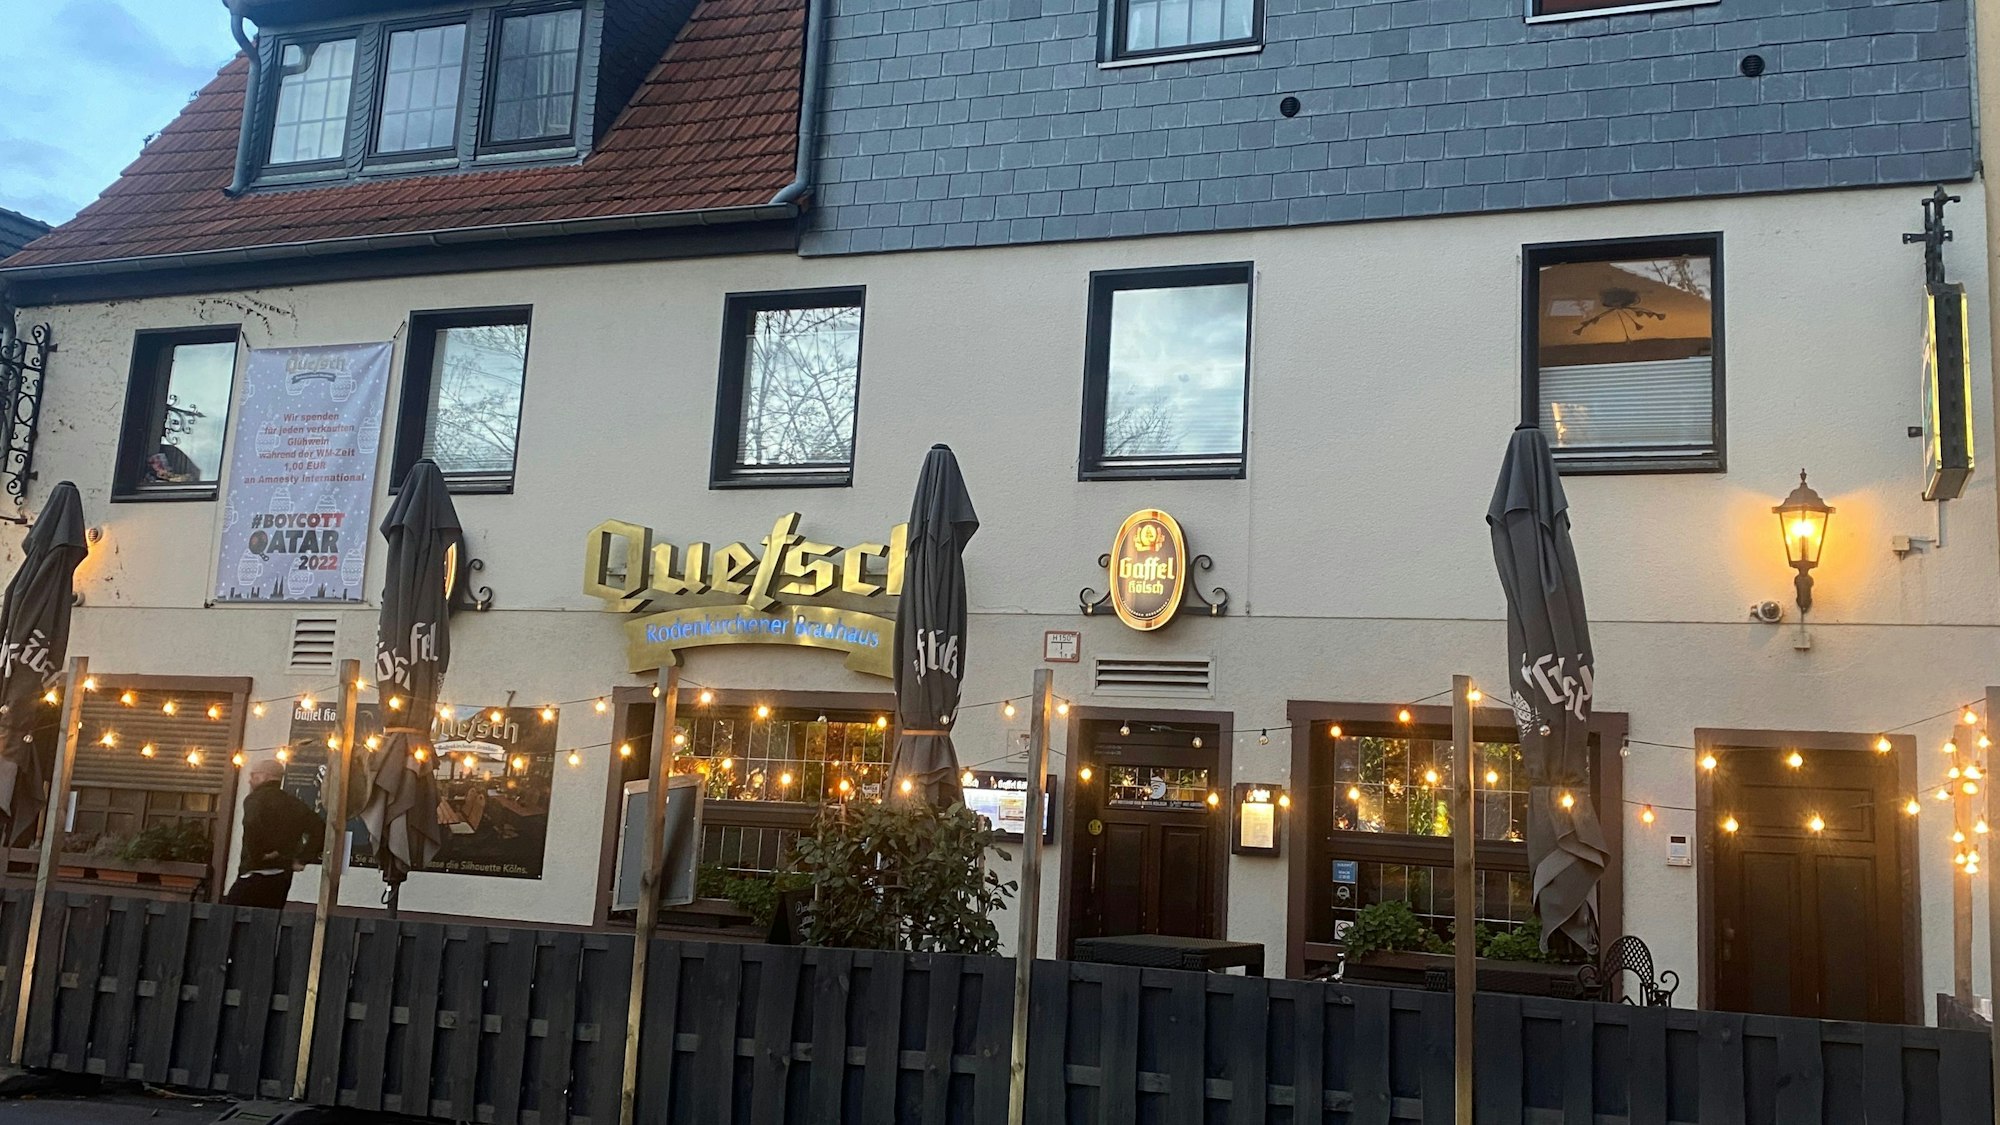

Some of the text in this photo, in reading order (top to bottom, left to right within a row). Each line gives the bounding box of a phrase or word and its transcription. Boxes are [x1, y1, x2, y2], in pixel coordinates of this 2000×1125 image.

[283, 412, 339, 423] Wir spenden
[264, 424, 355, 436] für jeden verkauften
[287, 436, 330, 446] Glühwein
[259, 447, 356, 459] während der WM-Zeit
[283, 461, 327, 472] 1,00 EUR
[243, 472, 365, 485] an Amnesty International
[251, 512, 346, 529] #BOYCOTT
[249, 530, 340, 557] QATAR
[298, 555, 338, 570] 2022
[1119, 556, 1175, 581] Gaffel
[1128, 580, 1164, 595] Kölsch
[646, 613, 880, 648] Rodenkirchener Brauhaus
[323, 707, 337, 722] Kö
[446, 859, 459, 870] die
[460, 860, 502, 873] Silhouette
[503, 863, 528, 875] Kölns.
